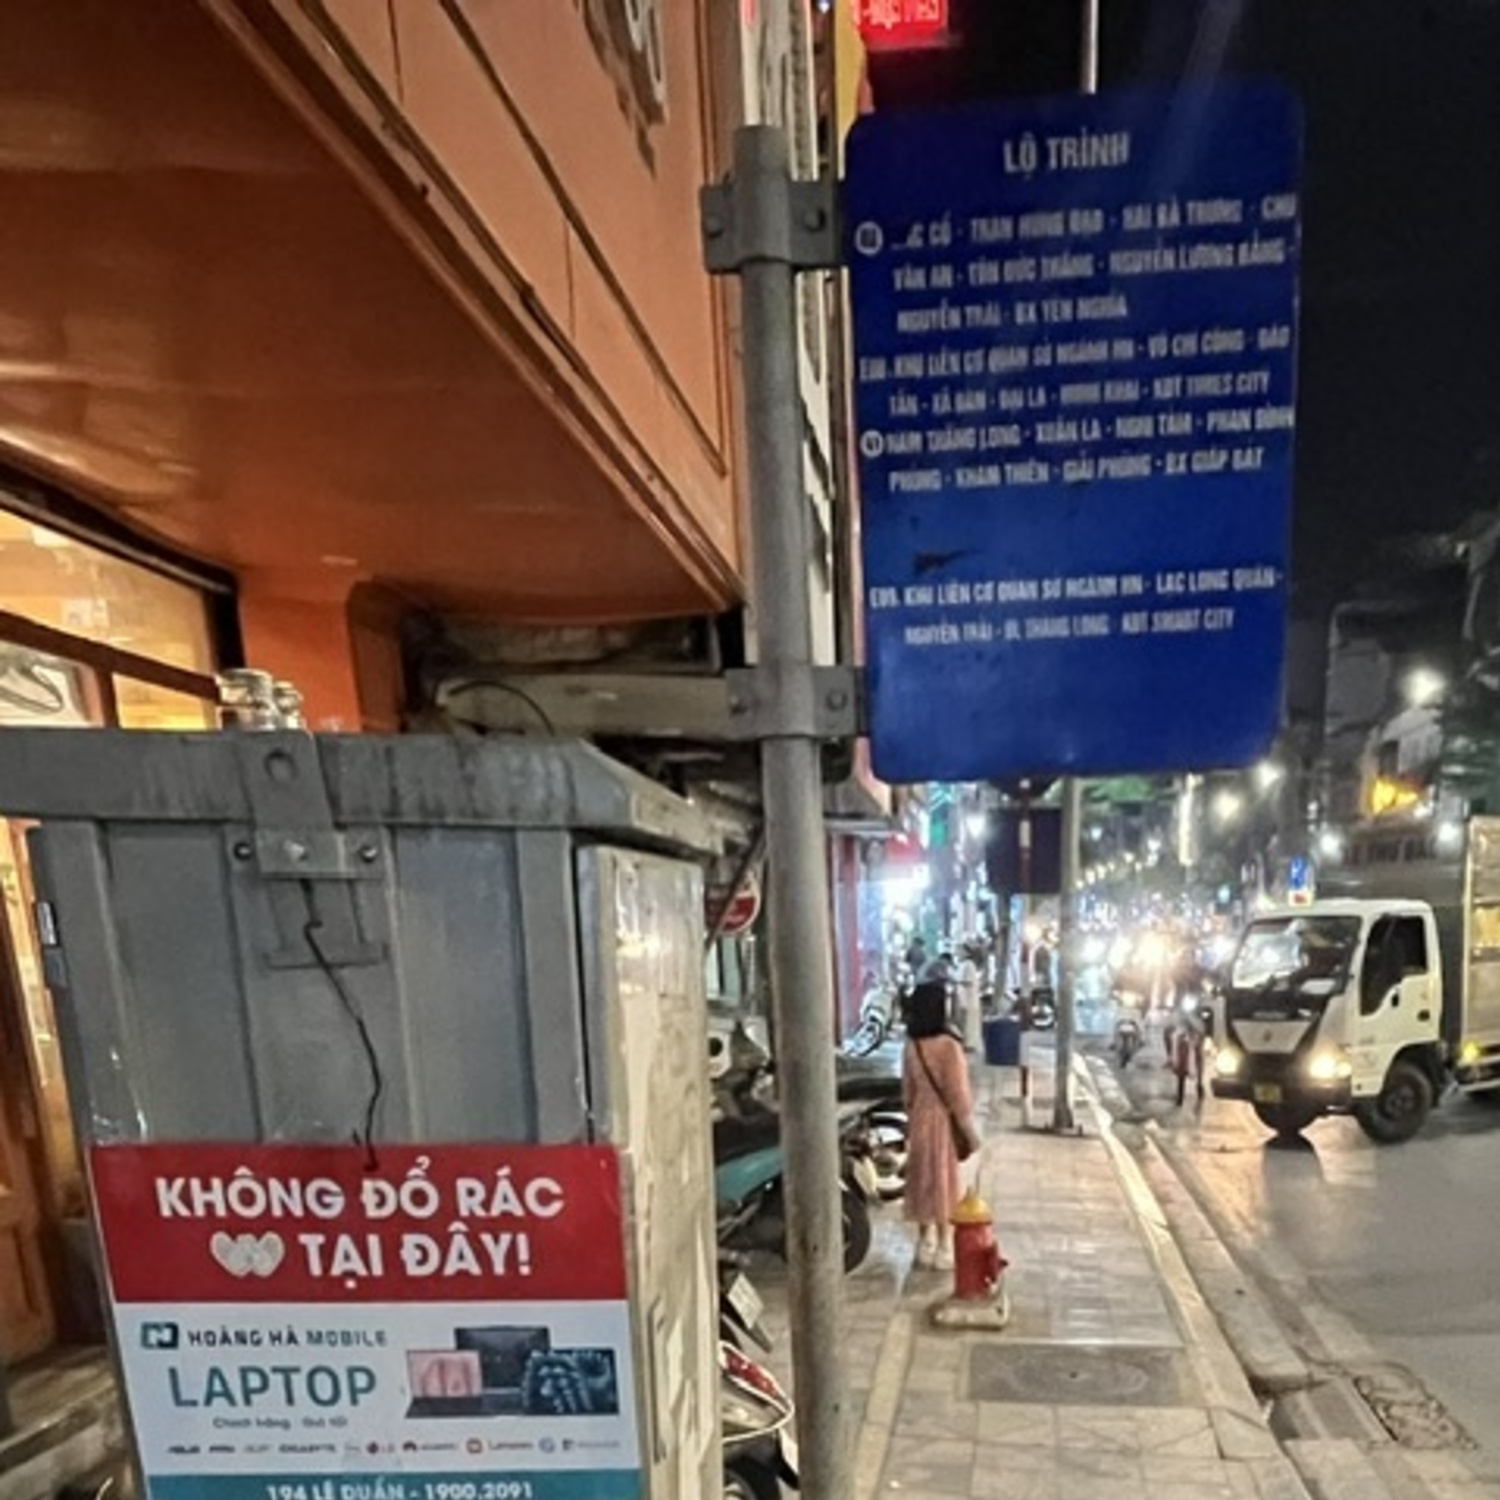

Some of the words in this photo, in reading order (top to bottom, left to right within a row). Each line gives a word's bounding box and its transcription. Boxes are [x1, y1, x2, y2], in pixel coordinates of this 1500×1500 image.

[1004, 133, 1037, 178] LỘ
[1047, 127, 1131, 171] TRÌNH
[155, 1167, 346, 1219] KHÔNG
[360, 1155, 440, 1219] ĐỔ
[455, 1165, 566, 1218] RÁC
[298, 1233, 383, 1289] TẠI
[400, 1221, 532, 1277] ĐÂY!
[187, 1325, 263, 1347] HOÀNG
[268, 1325, 300, 1346] HÀ
[305, 1329, 388, 1347] MOBILE
[167, 1365, 377, 1407] LAPTOP
[424, 1481, 533, 1500] 1900.2091
